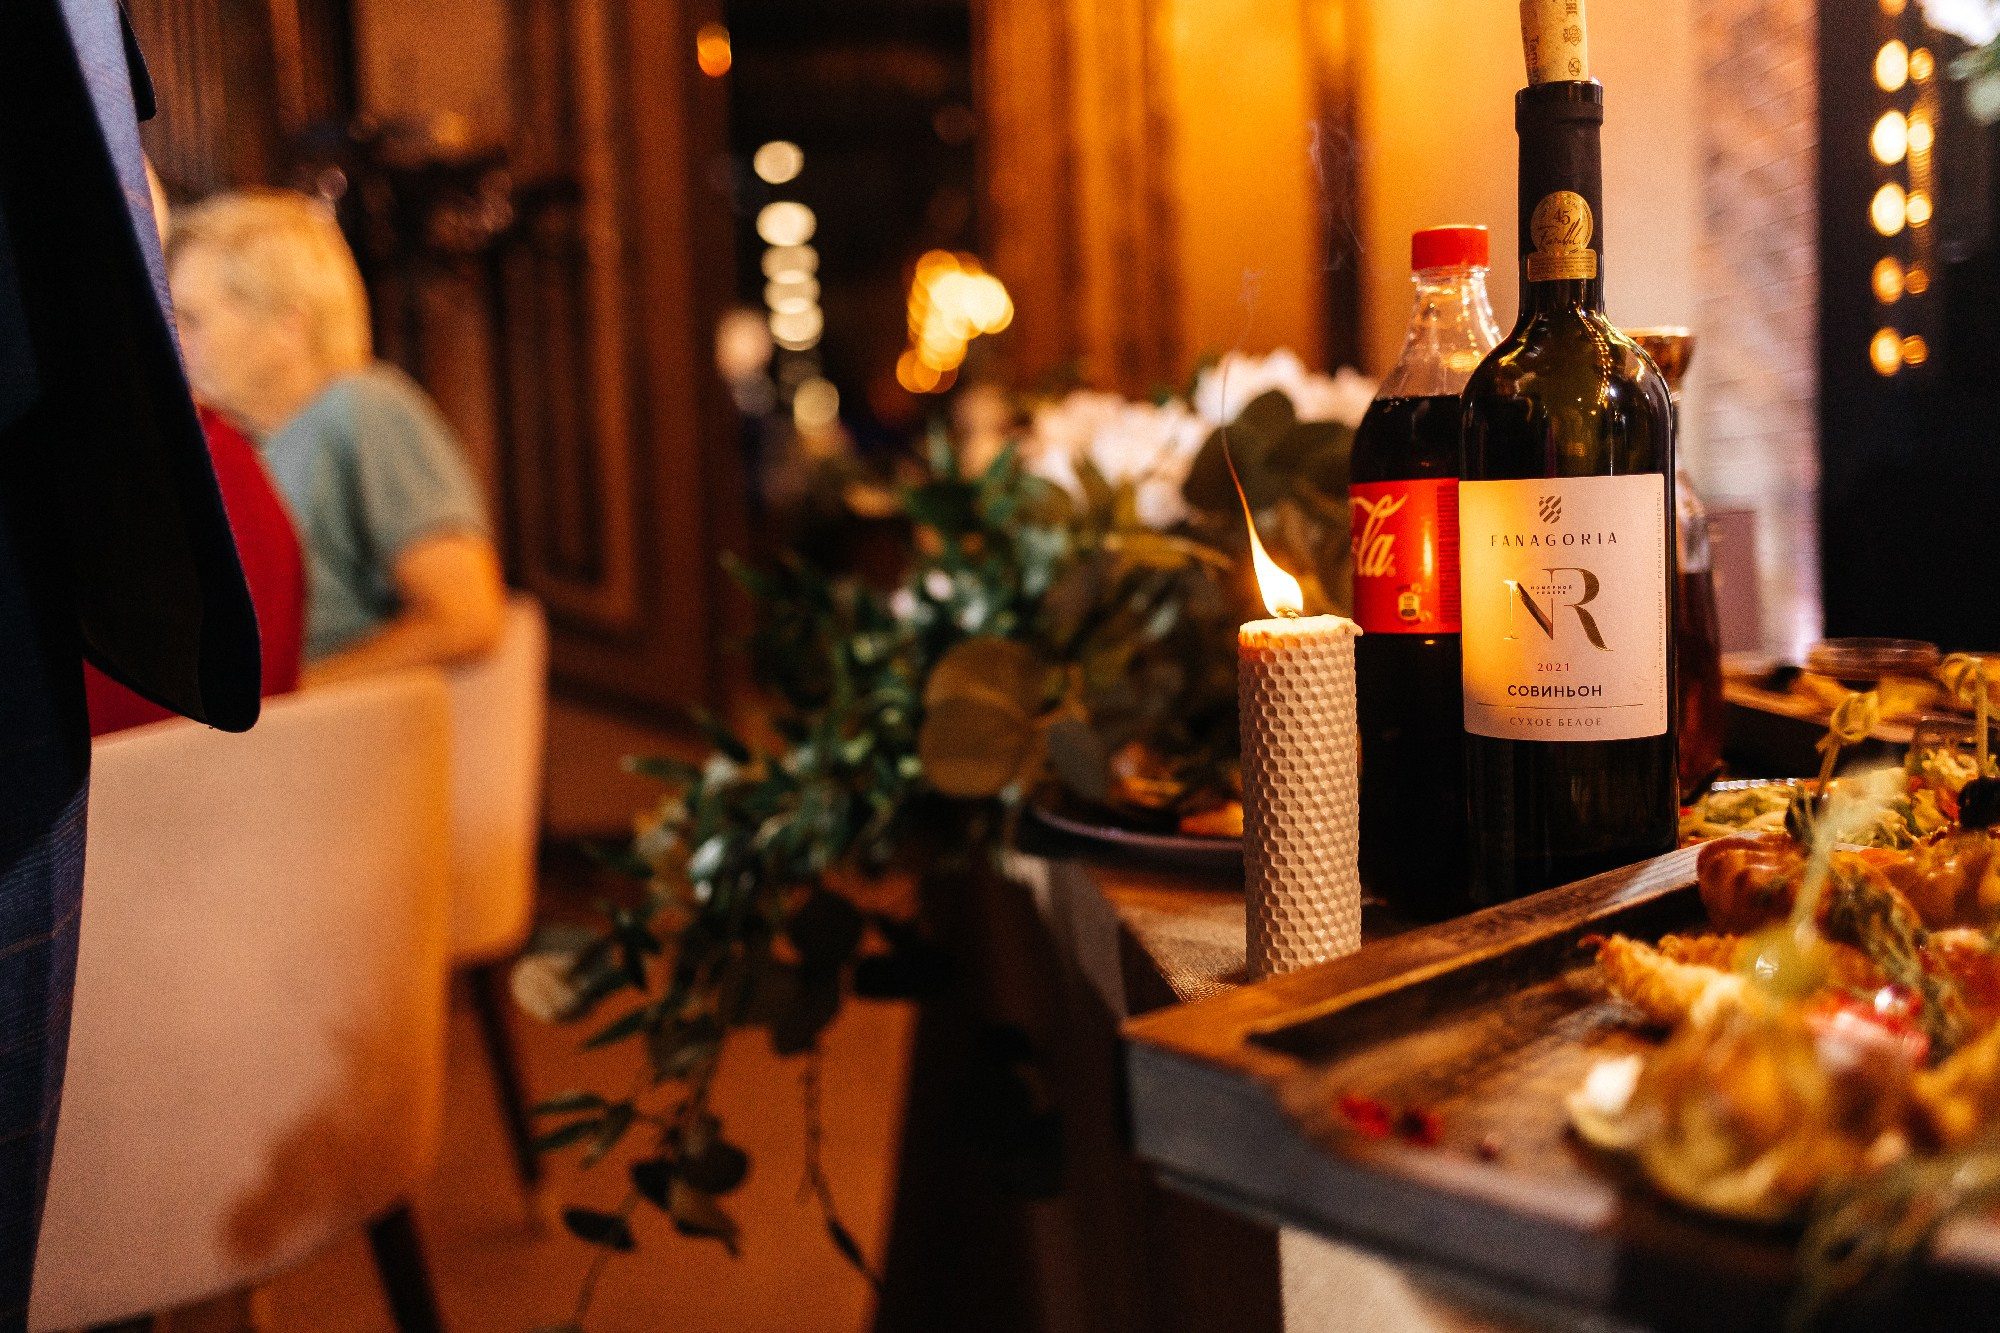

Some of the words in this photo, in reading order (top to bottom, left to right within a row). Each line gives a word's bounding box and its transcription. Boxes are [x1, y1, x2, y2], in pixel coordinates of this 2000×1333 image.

[1491, 532, 1618, 547] FANAGORIA
[1537, 662, 1570, 672] 2021
[1507, 684, 1602, 697] СОВИНЬОН
[1510, 717, 1553, 727] СУХОЕ
[1558, 717, 1602, 727] БЕЛОЕ
